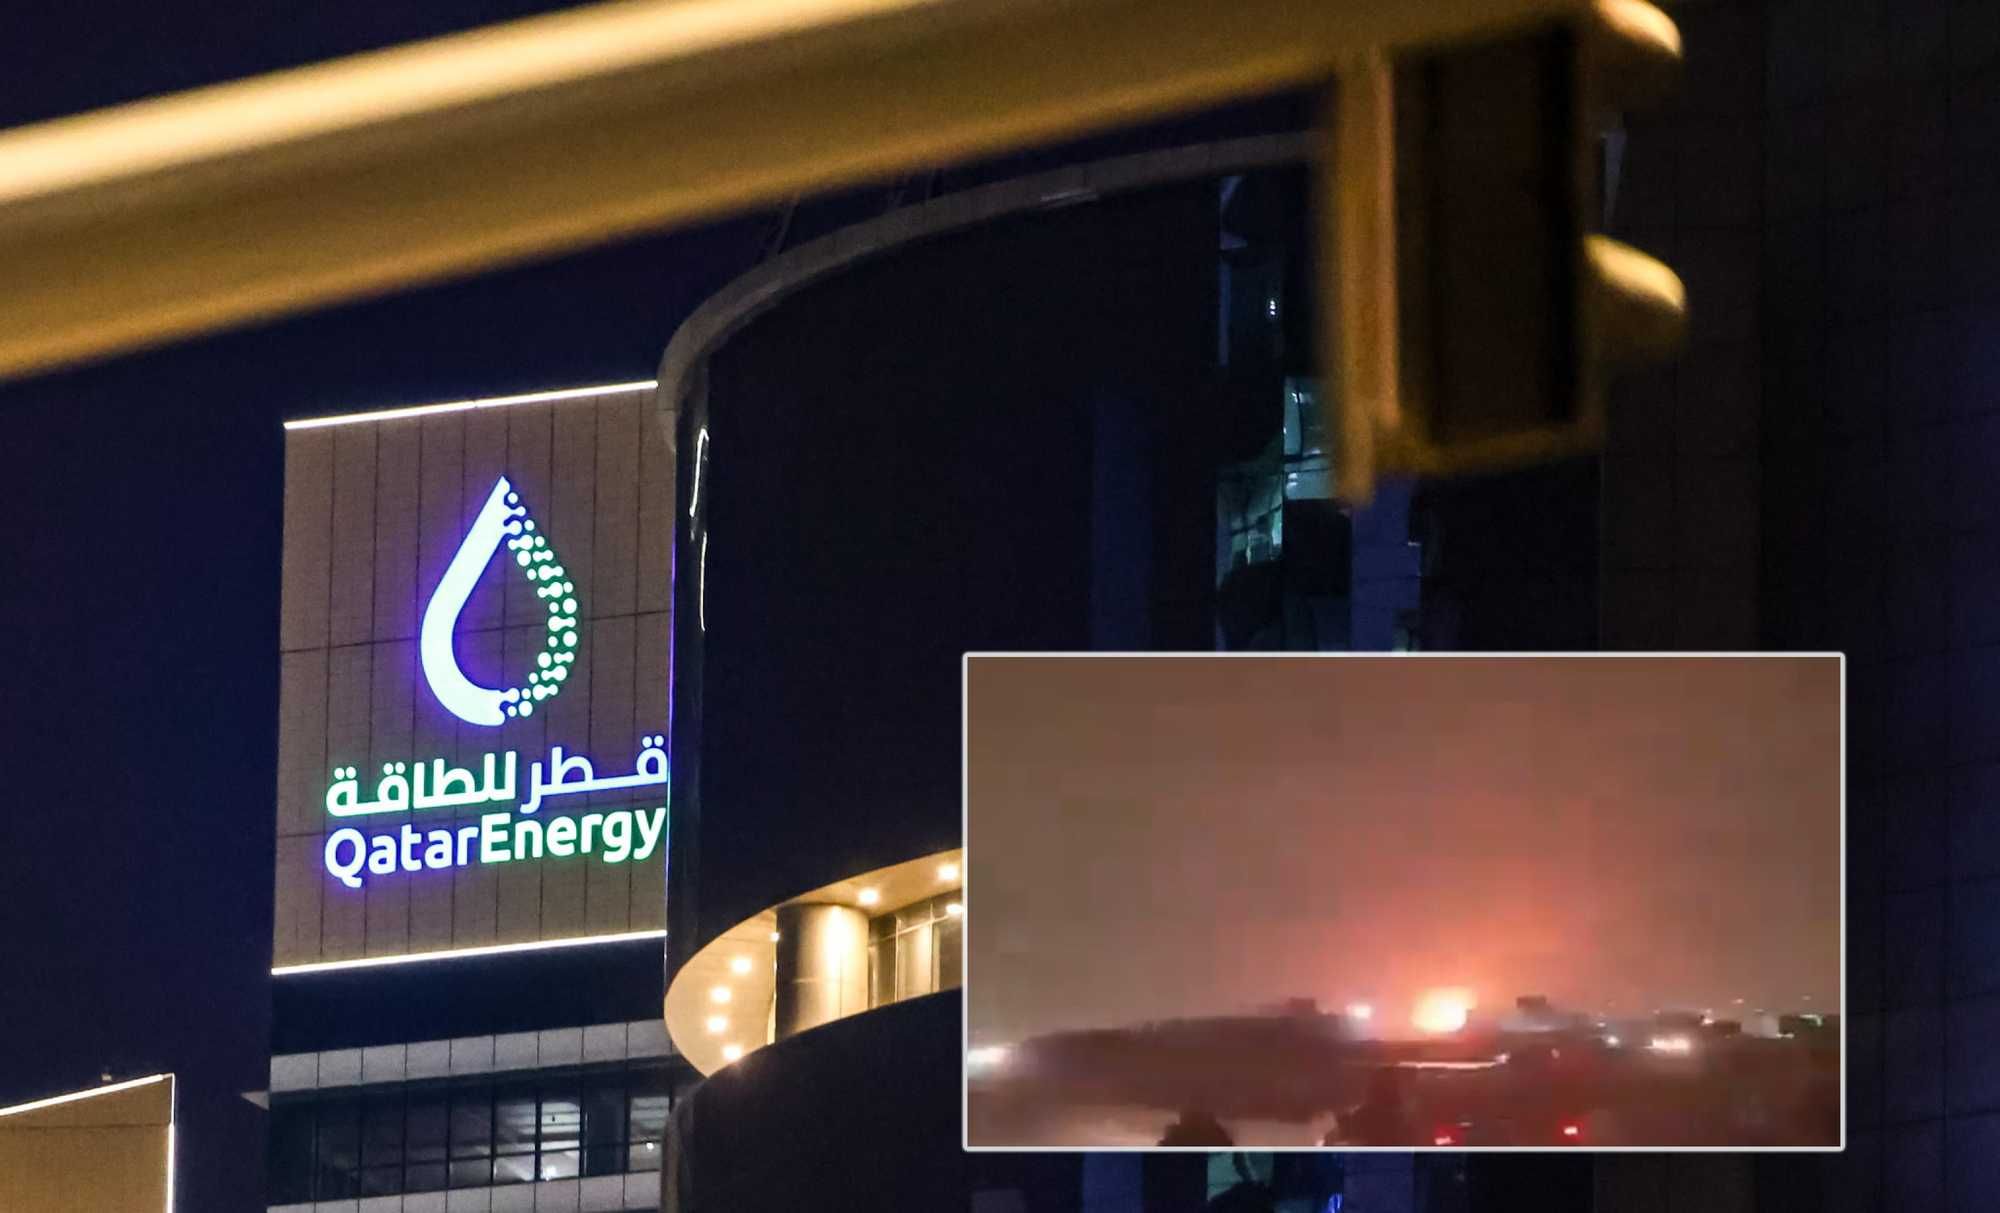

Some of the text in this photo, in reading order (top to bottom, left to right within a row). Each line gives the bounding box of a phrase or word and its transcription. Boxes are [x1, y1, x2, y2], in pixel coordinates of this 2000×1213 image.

[326, 735, 668, 817] قطر للطاقة
[324, 807, 666, 888] QatarEnergy
